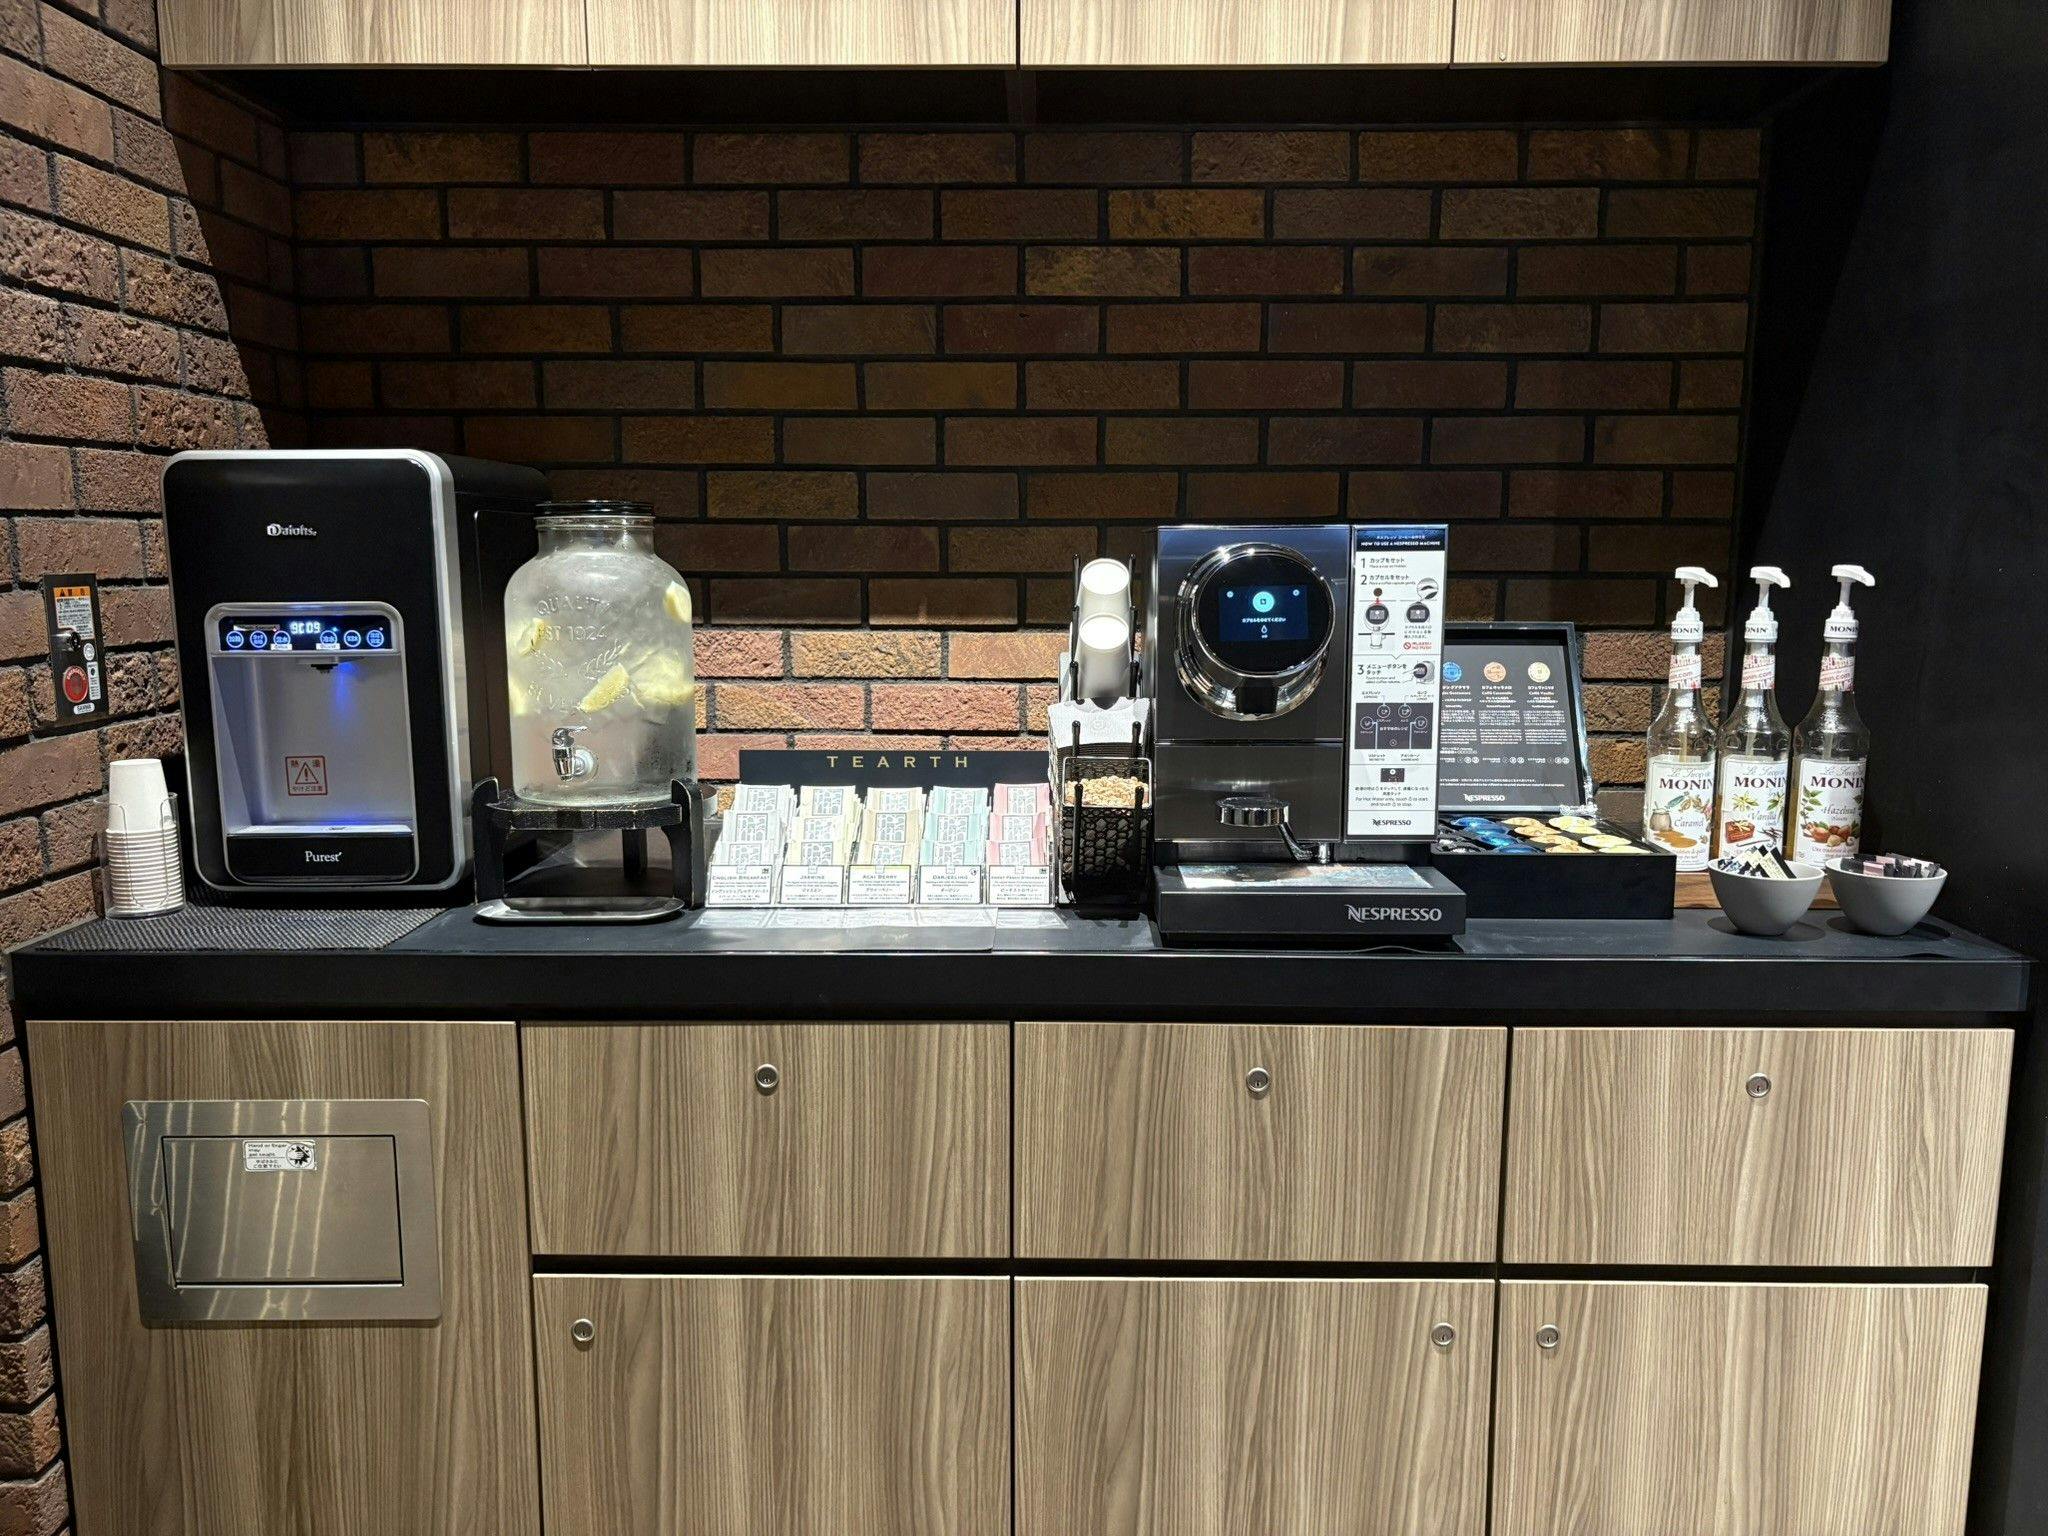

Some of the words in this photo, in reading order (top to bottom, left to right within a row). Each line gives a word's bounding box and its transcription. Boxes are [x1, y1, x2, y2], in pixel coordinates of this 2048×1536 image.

[1361, 557, 1366, 569] 1
[1361, 575, 1367, 585] 2
[1357, 664, 1364, 675] 3
[827, 756, 968, 768] TEARTH
[1463, 793, 1506, 802] NESPRESSO
[1372, 818, 1412, 826] NESPRESSO
[1344, 904, 1442, 923] NESPRESSO
